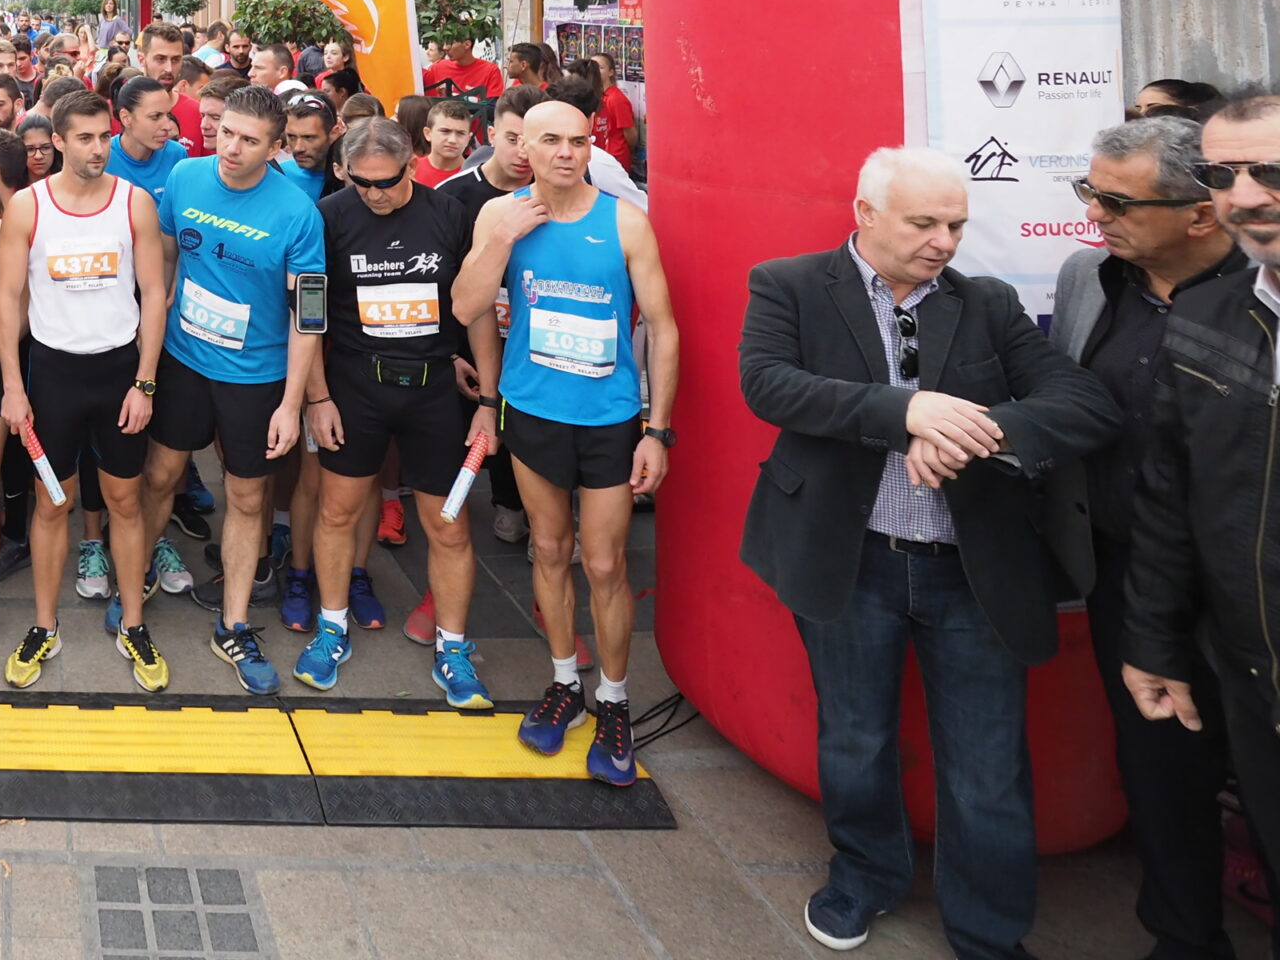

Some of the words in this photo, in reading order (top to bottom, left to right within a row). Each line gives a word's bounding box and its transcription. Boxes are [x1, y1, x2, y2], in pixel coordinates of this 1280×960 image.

[1037, 70, 1113, 87] RENAULT
[1038, 90, 1075, 101] Passion
[1075, 90, 1088, 100] for
[1089, 88, 1102, 99] life
[1028, 153, 1090, 169] VERONIS
[182, 207, 271, 241] DYNAFIT
[53, 255, 112, 275] 437-1
[350, 254, 406, 274] Teachers
[184, 301, 237, 335] 1074
[365, 302, 432, 322] 417-1
[544, 330, 605, 356] 1039
